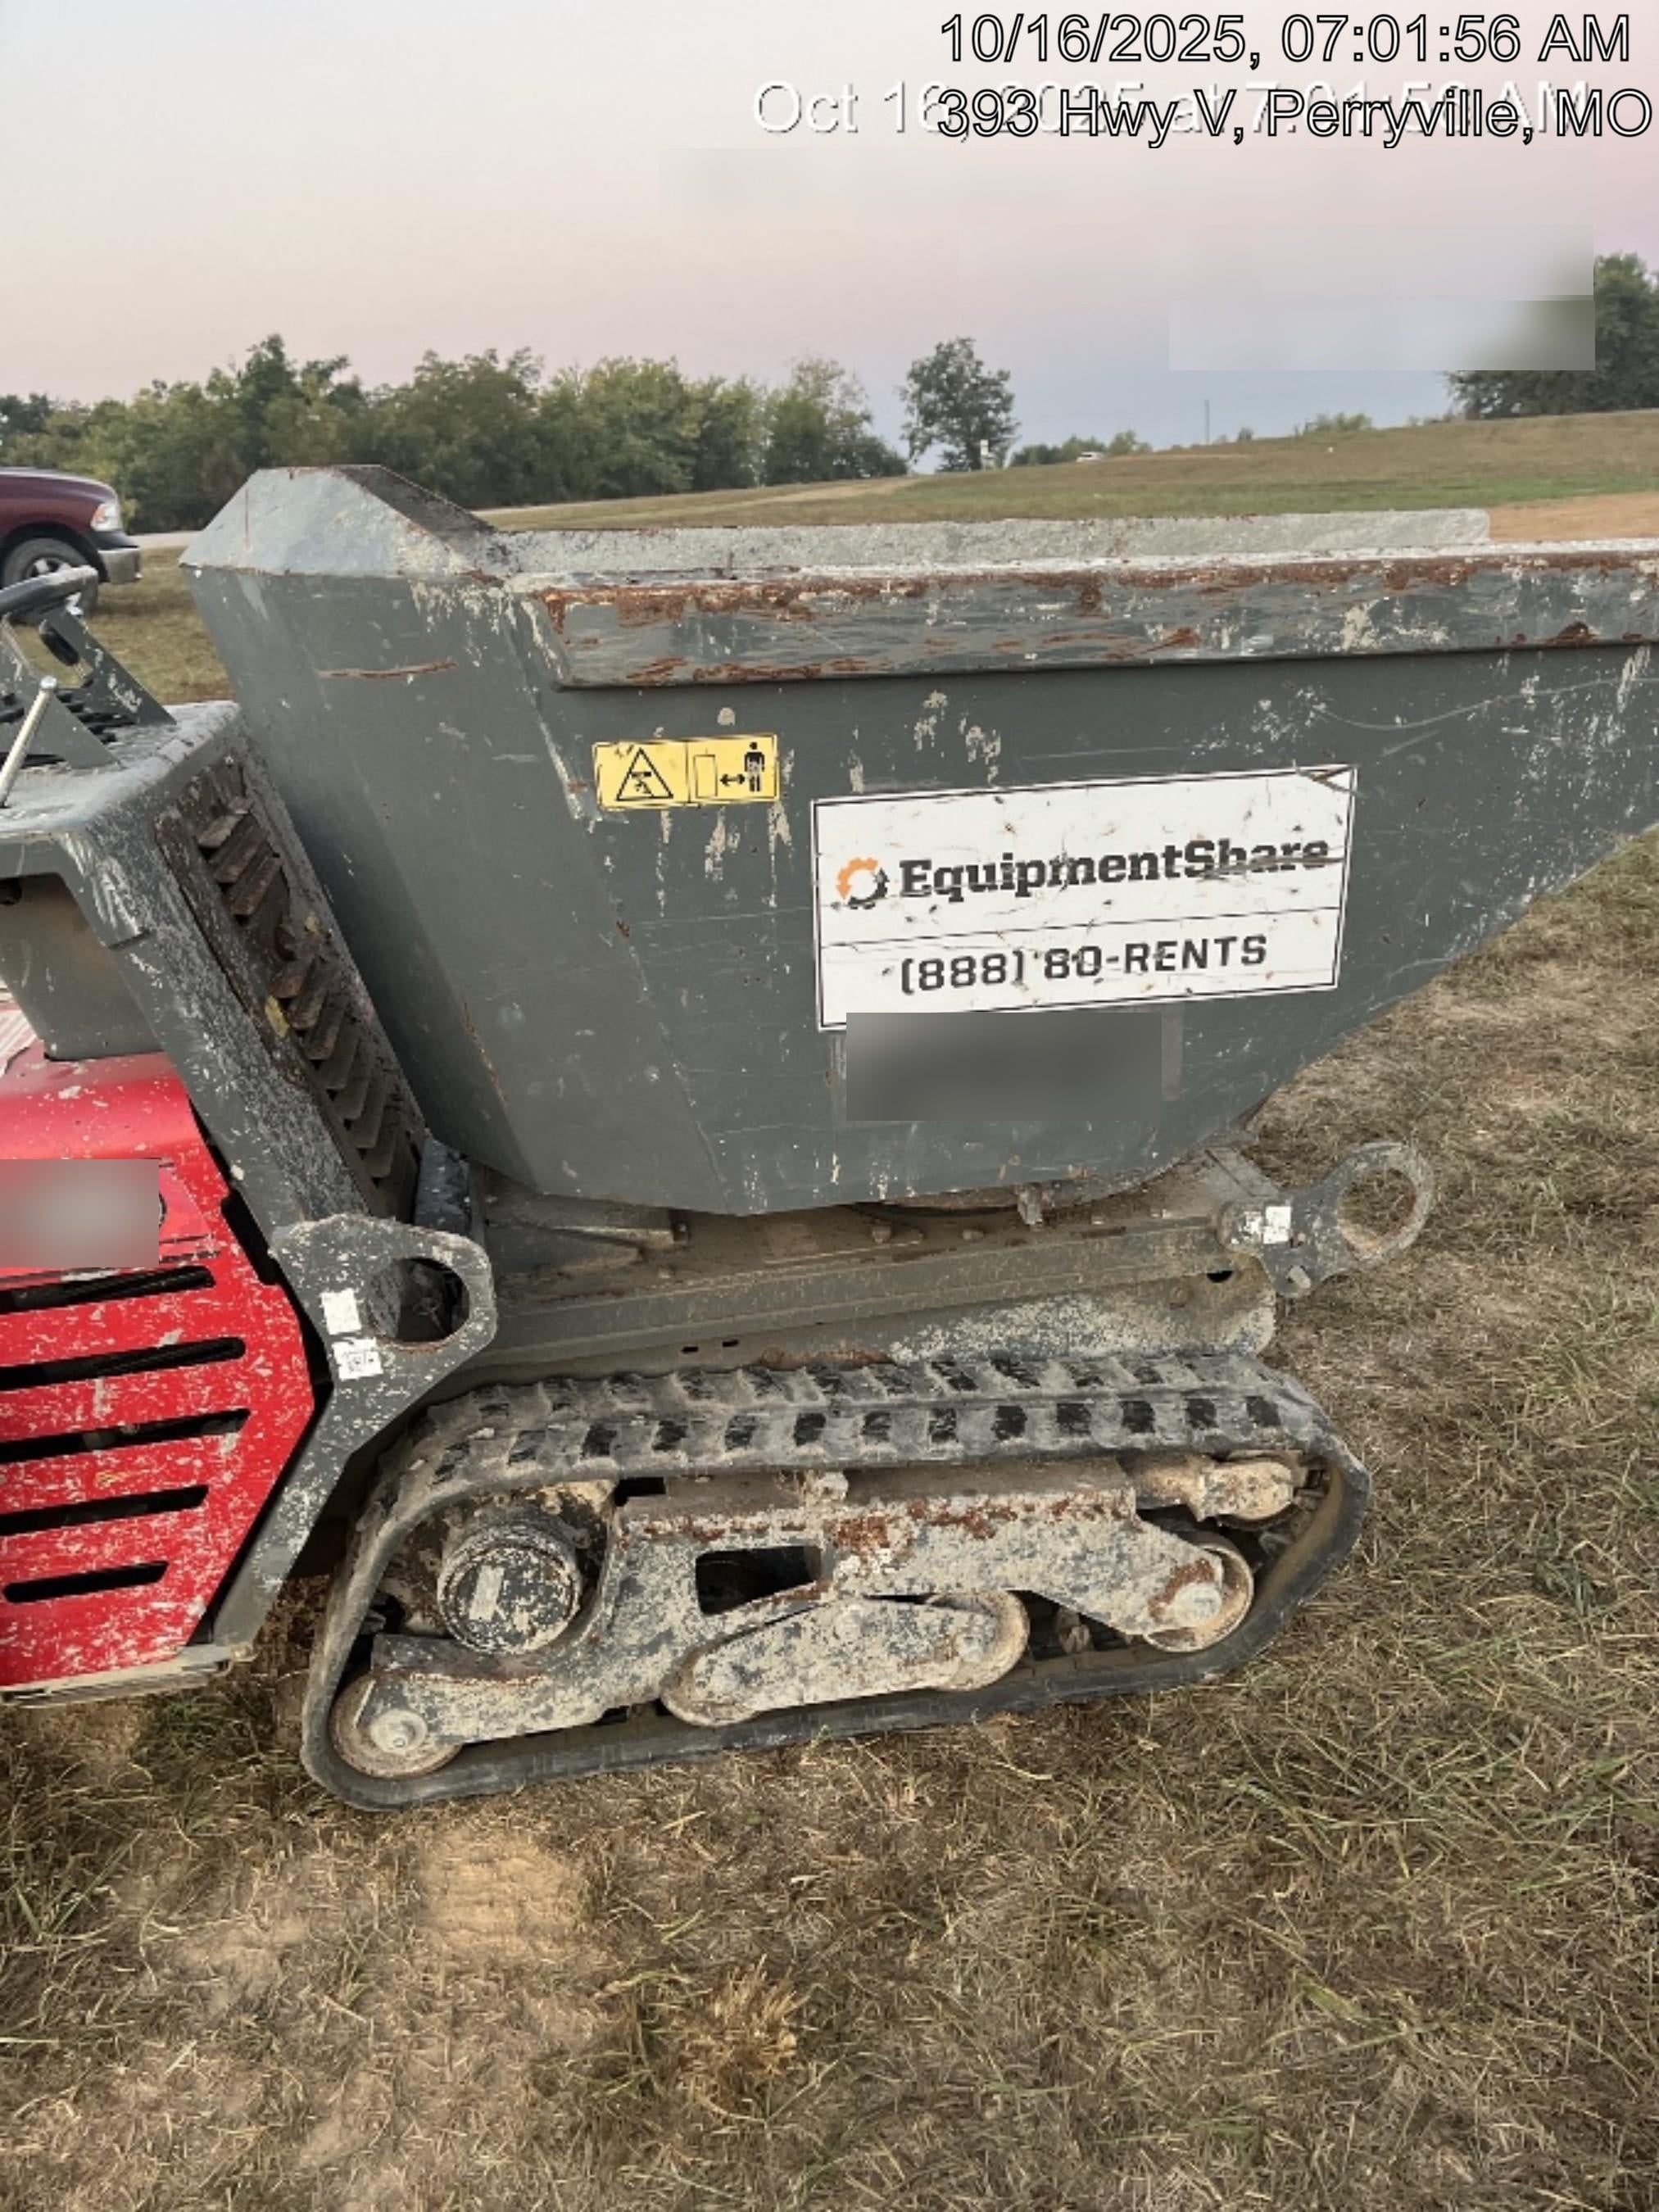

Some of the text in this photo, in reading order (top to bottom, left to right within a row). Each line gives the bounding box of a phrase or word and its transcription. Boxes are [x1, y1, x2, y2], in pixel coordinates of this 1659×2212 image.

[899, 837, 1329, 902] EquipmentShare
[901, 934, 1267, 994] (888) 80-RENTS
